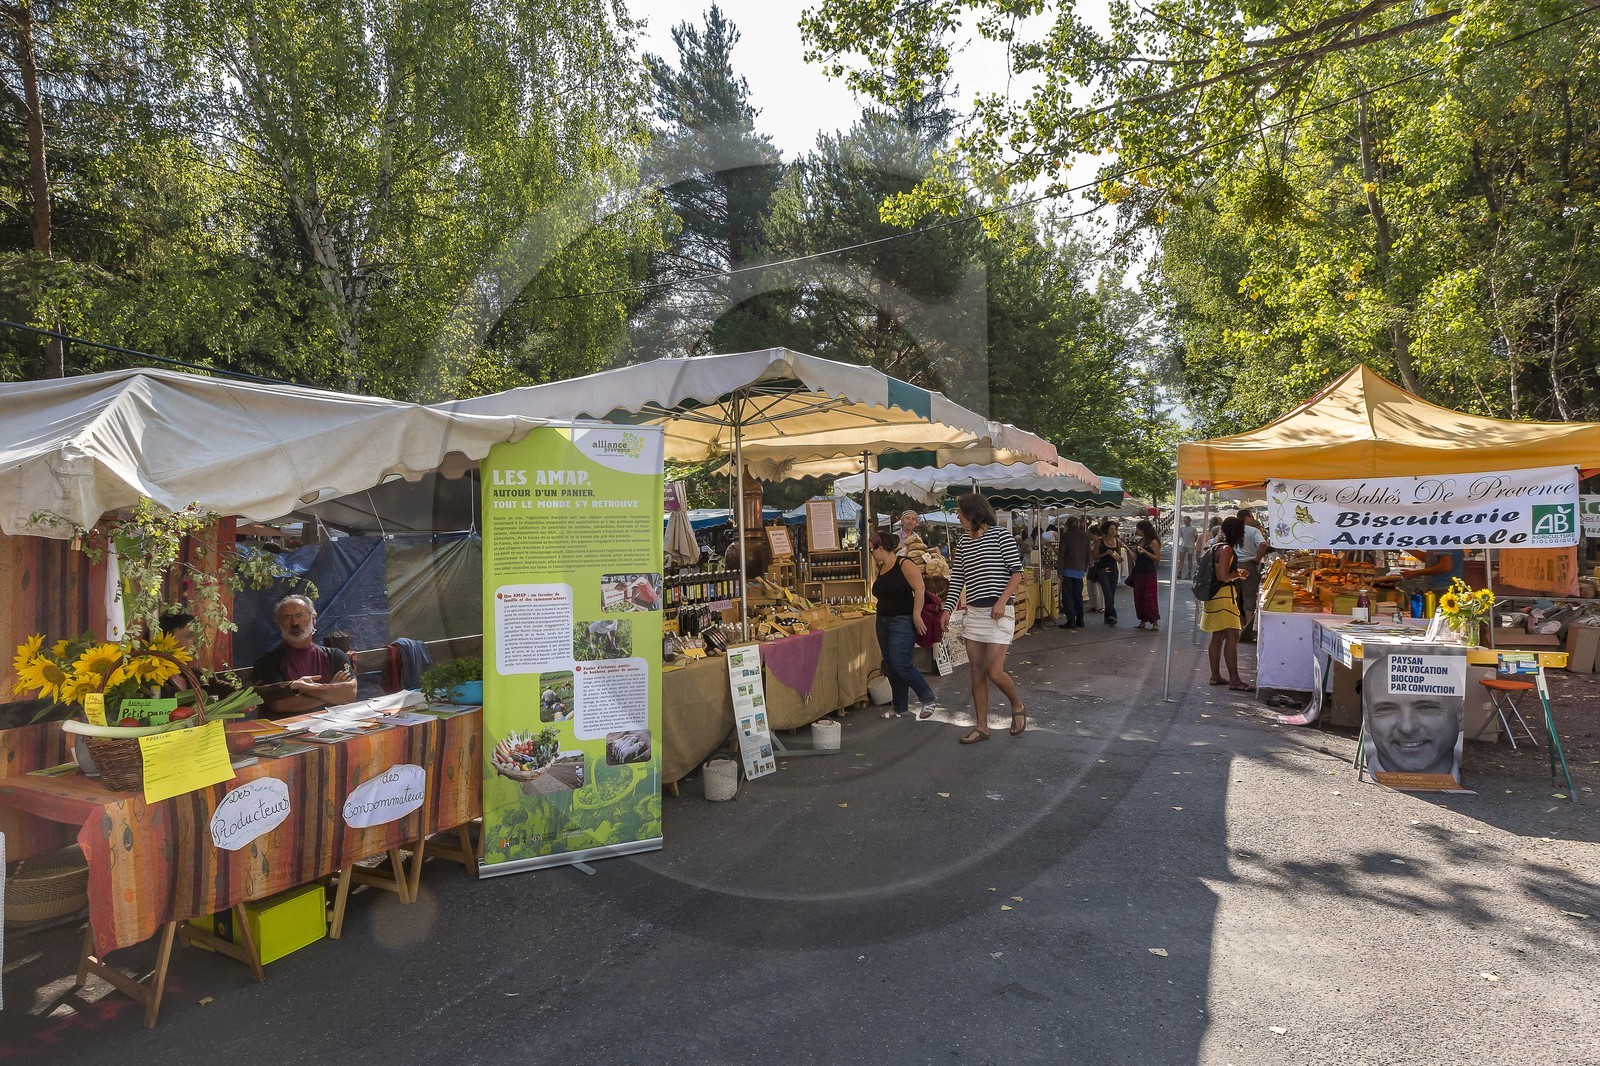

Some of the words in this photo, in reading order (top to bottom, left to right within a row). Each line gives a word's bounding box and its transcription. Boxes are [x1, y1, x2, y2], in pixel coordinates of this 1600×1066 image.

[592, 439, 628, 449] alliance
[492, 470, 527, 486] LES
[536, 470, 592, 487] AMAP,
[493, 490, 530, 498] AUTOUR
[535, 489, 558, 498] D'UN
[1289, 484, 1328, 504] Les
[1336, 483, 1400, 508] Sablés
[1412, 479, 1456, 504] De
[1468, 475, 1576, 500] Provence
[493, 501, 517, 509] TOUT
[1335, 508, 1520, 528] Biscuiterie
[1534, 513, 1569, 534] AB
[1329, 529, 1528, 548] Artisanale
[1391, 656, 1423, 665] PAYSAN
[1391, 665, 1407, 673] PAR
[1410, 666, 1448, 675] VOCATION
[1391, 674, 1425, 683] BIOCOOP
[1408, 684, 1455, 694] CONVICTION
[122, 708, 144, 718] Petit
[148, 709, 172, 720] panie
[382, 773, 399, 784] des
[229, 790, 250, 804] Des
[211, 796, 289, 845] Producteurs
